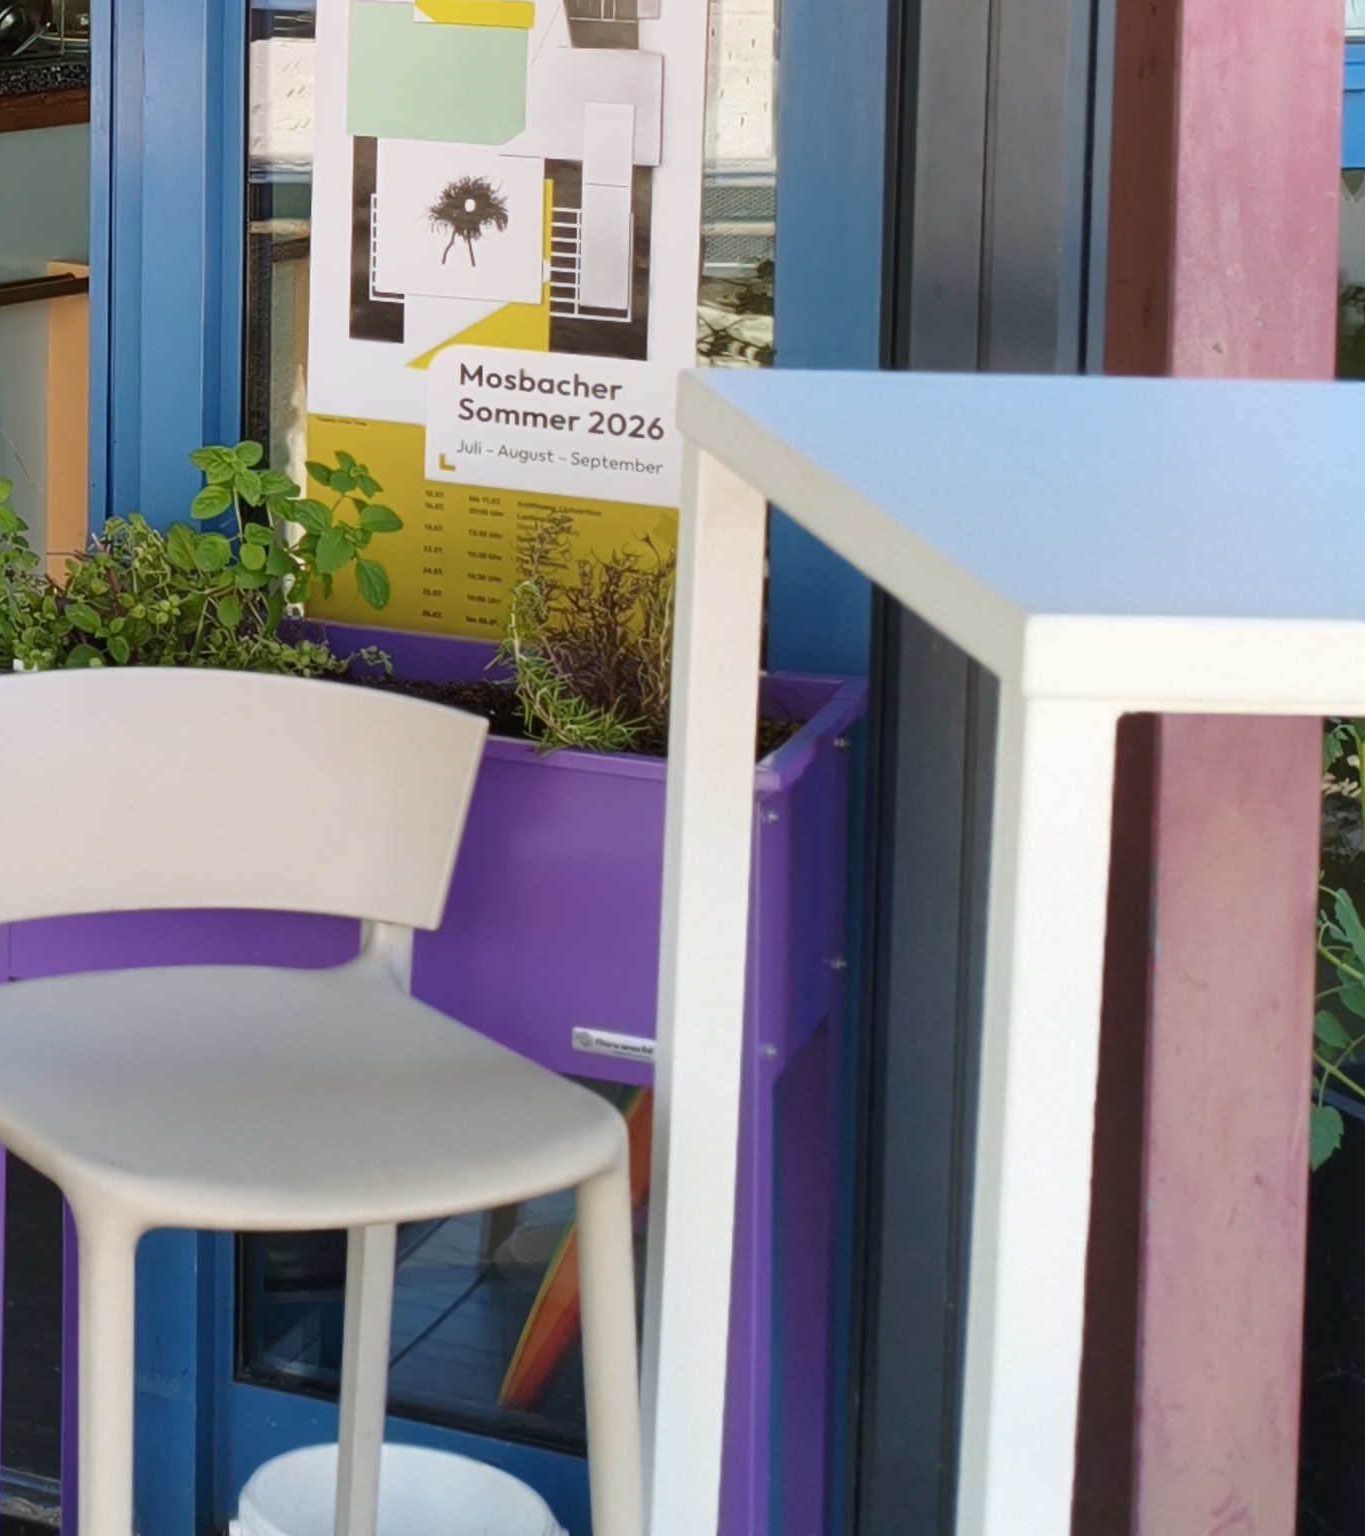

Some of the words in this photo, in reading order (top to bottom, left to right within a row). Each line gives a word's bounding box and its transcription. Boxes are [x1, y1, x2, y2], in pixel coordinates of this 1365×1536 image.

[459, 363, 623, 401] Mosbacher
[458, 397, 581, 432] Sommer
[587, 410, 665, 440] 2026
[456, 439, 483, 455] Juli
[497, 444, 554, 464] August
[570, 451, 664, 475] September
[488, 530, 503, 539] Uhr
[488, 553, 502, 561] Uhr
[488, 574, 502, 583] Uhr
